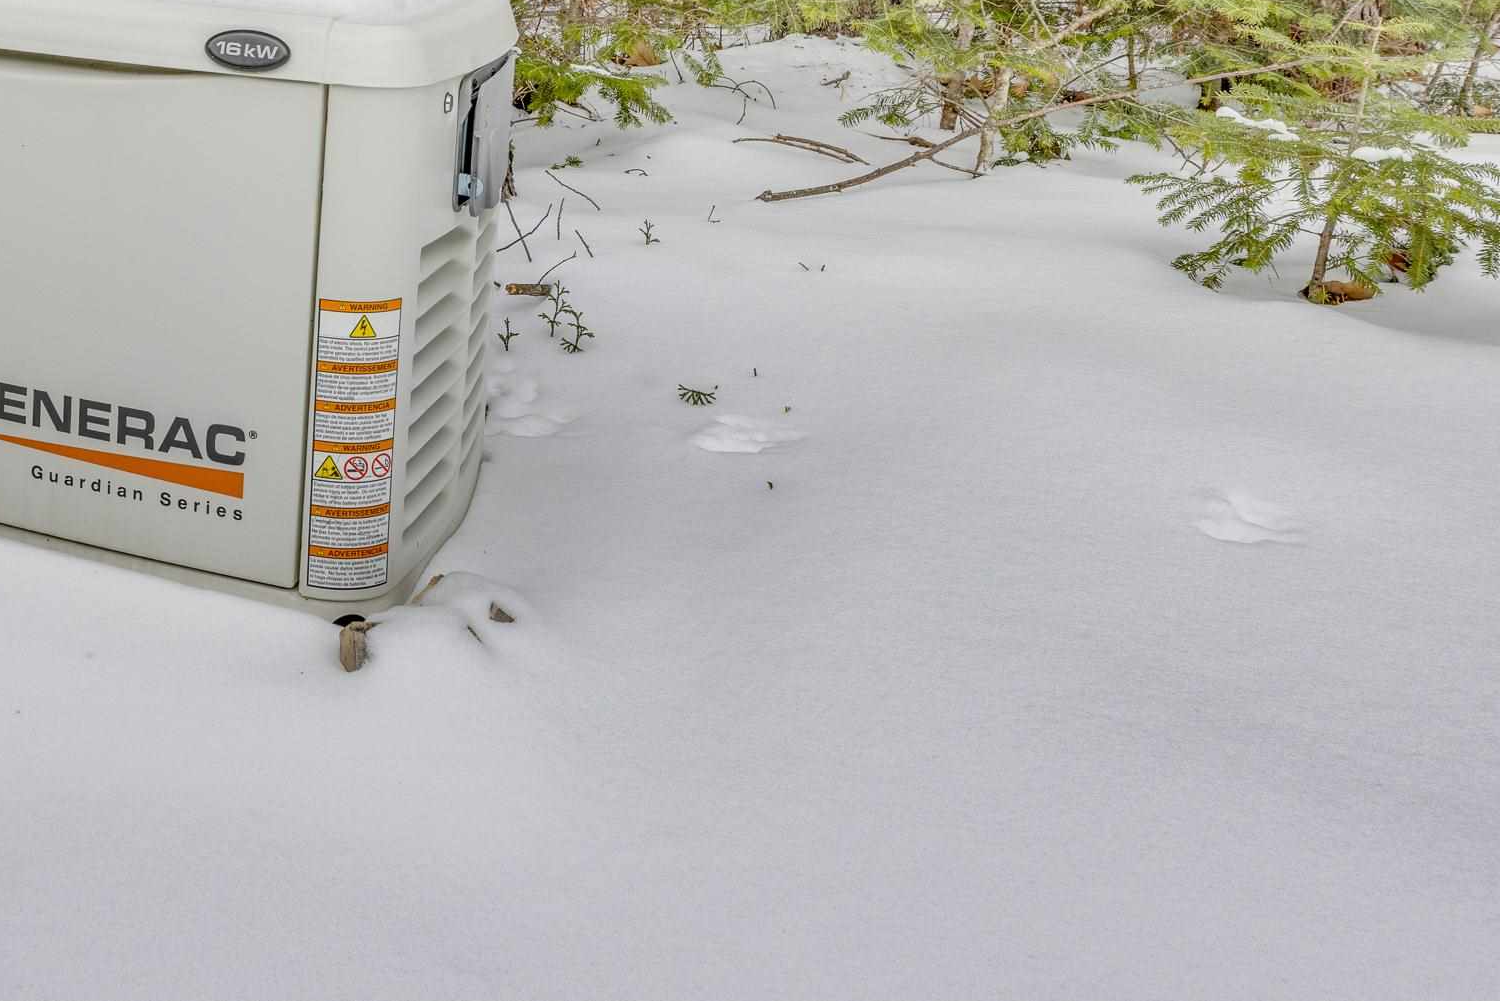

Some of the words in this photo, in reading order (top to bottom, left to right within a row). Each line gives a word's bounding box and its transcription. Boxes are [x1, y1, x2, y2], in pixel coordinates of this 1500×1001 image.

[350, 303, 389, 312] WARNING
[343, 443, 381, 452] WARNING
[31, 465, 143, 502] Guardian
[160, 491, 244, 522] Series
